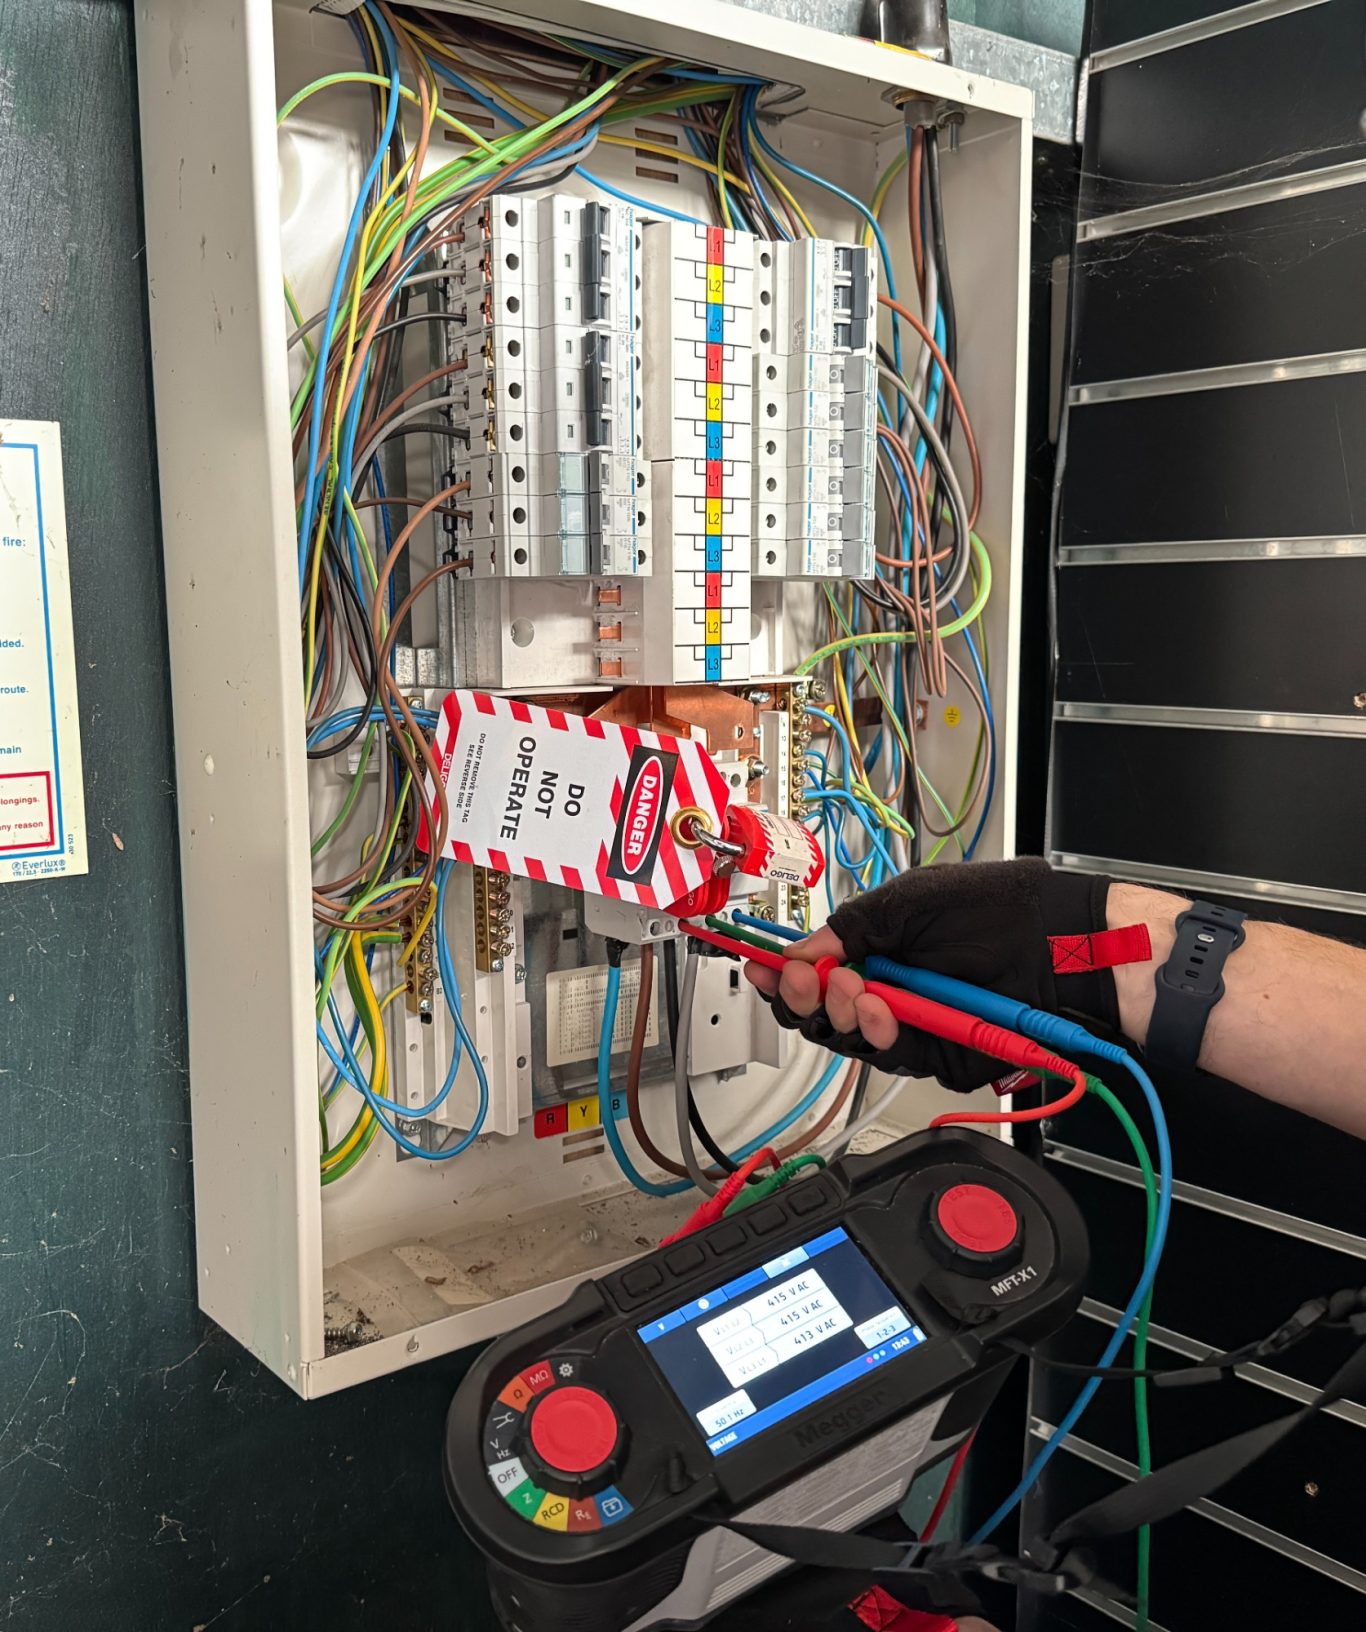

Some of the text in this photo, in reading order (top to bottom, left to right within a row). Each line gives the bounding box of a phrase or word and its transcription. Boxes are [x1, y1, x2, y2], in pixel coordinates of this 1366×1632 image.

[708, 279, 721, 292] L2
[709, 320, 721, 333] L3
[708, 358, 719, 371] L1
[708, 398, 720, 410] L2
[708, 436, 720, 449] L3
[708, 474, 719, 487] L1
[708, 513, 720, 525] L2
[2, 536, 26, 547] fire:
[707, 550, 720, 562] L3
[707, 585, 718, 597] L1
[707, 622, 719, 634] L2
[707, 658, 719, 670] L3
[0, 685, 29, 694] route.
[456, 743, 475, 809] SEE REVERSE SIDE
[462, 732, 487, 824] DO NOT REMOVE THIS TAG
[499, 736, 537, 841] OPERATE
[534, 770, 559, 819] NOT
[564, 783, 585, 817] DO
[627, 774, 658, 856] DANGER
[14, 821, 43, 830] reason
[769, 869, 800, 882] DELIGO
[580, 1105, 588, 1118] Y
[612, 1099, 620, 1111] B
[546, 1112, 555, 1125] R
[990, 1265, 1038, 1297] MFT-X1
[767, 1281, 810, 1307] 415 V AC
[780, 1299, 823, 1325] 415 V AC
[794, 1318, 837, 1345] 413 V AC
[529, 1369, 549, 1386] MΩ
[733, 1409, 744, 1418] Hz
[792, 1390, 886, 1449] Megger
[489, 1438, 500, 1450] V
[496, 1448, 511, 1460] Hz
[496, 1466, 519, 1485] OFF
[522, 1492, 533, 1504] Z
[541, 1501, 566, 1521] RCD
